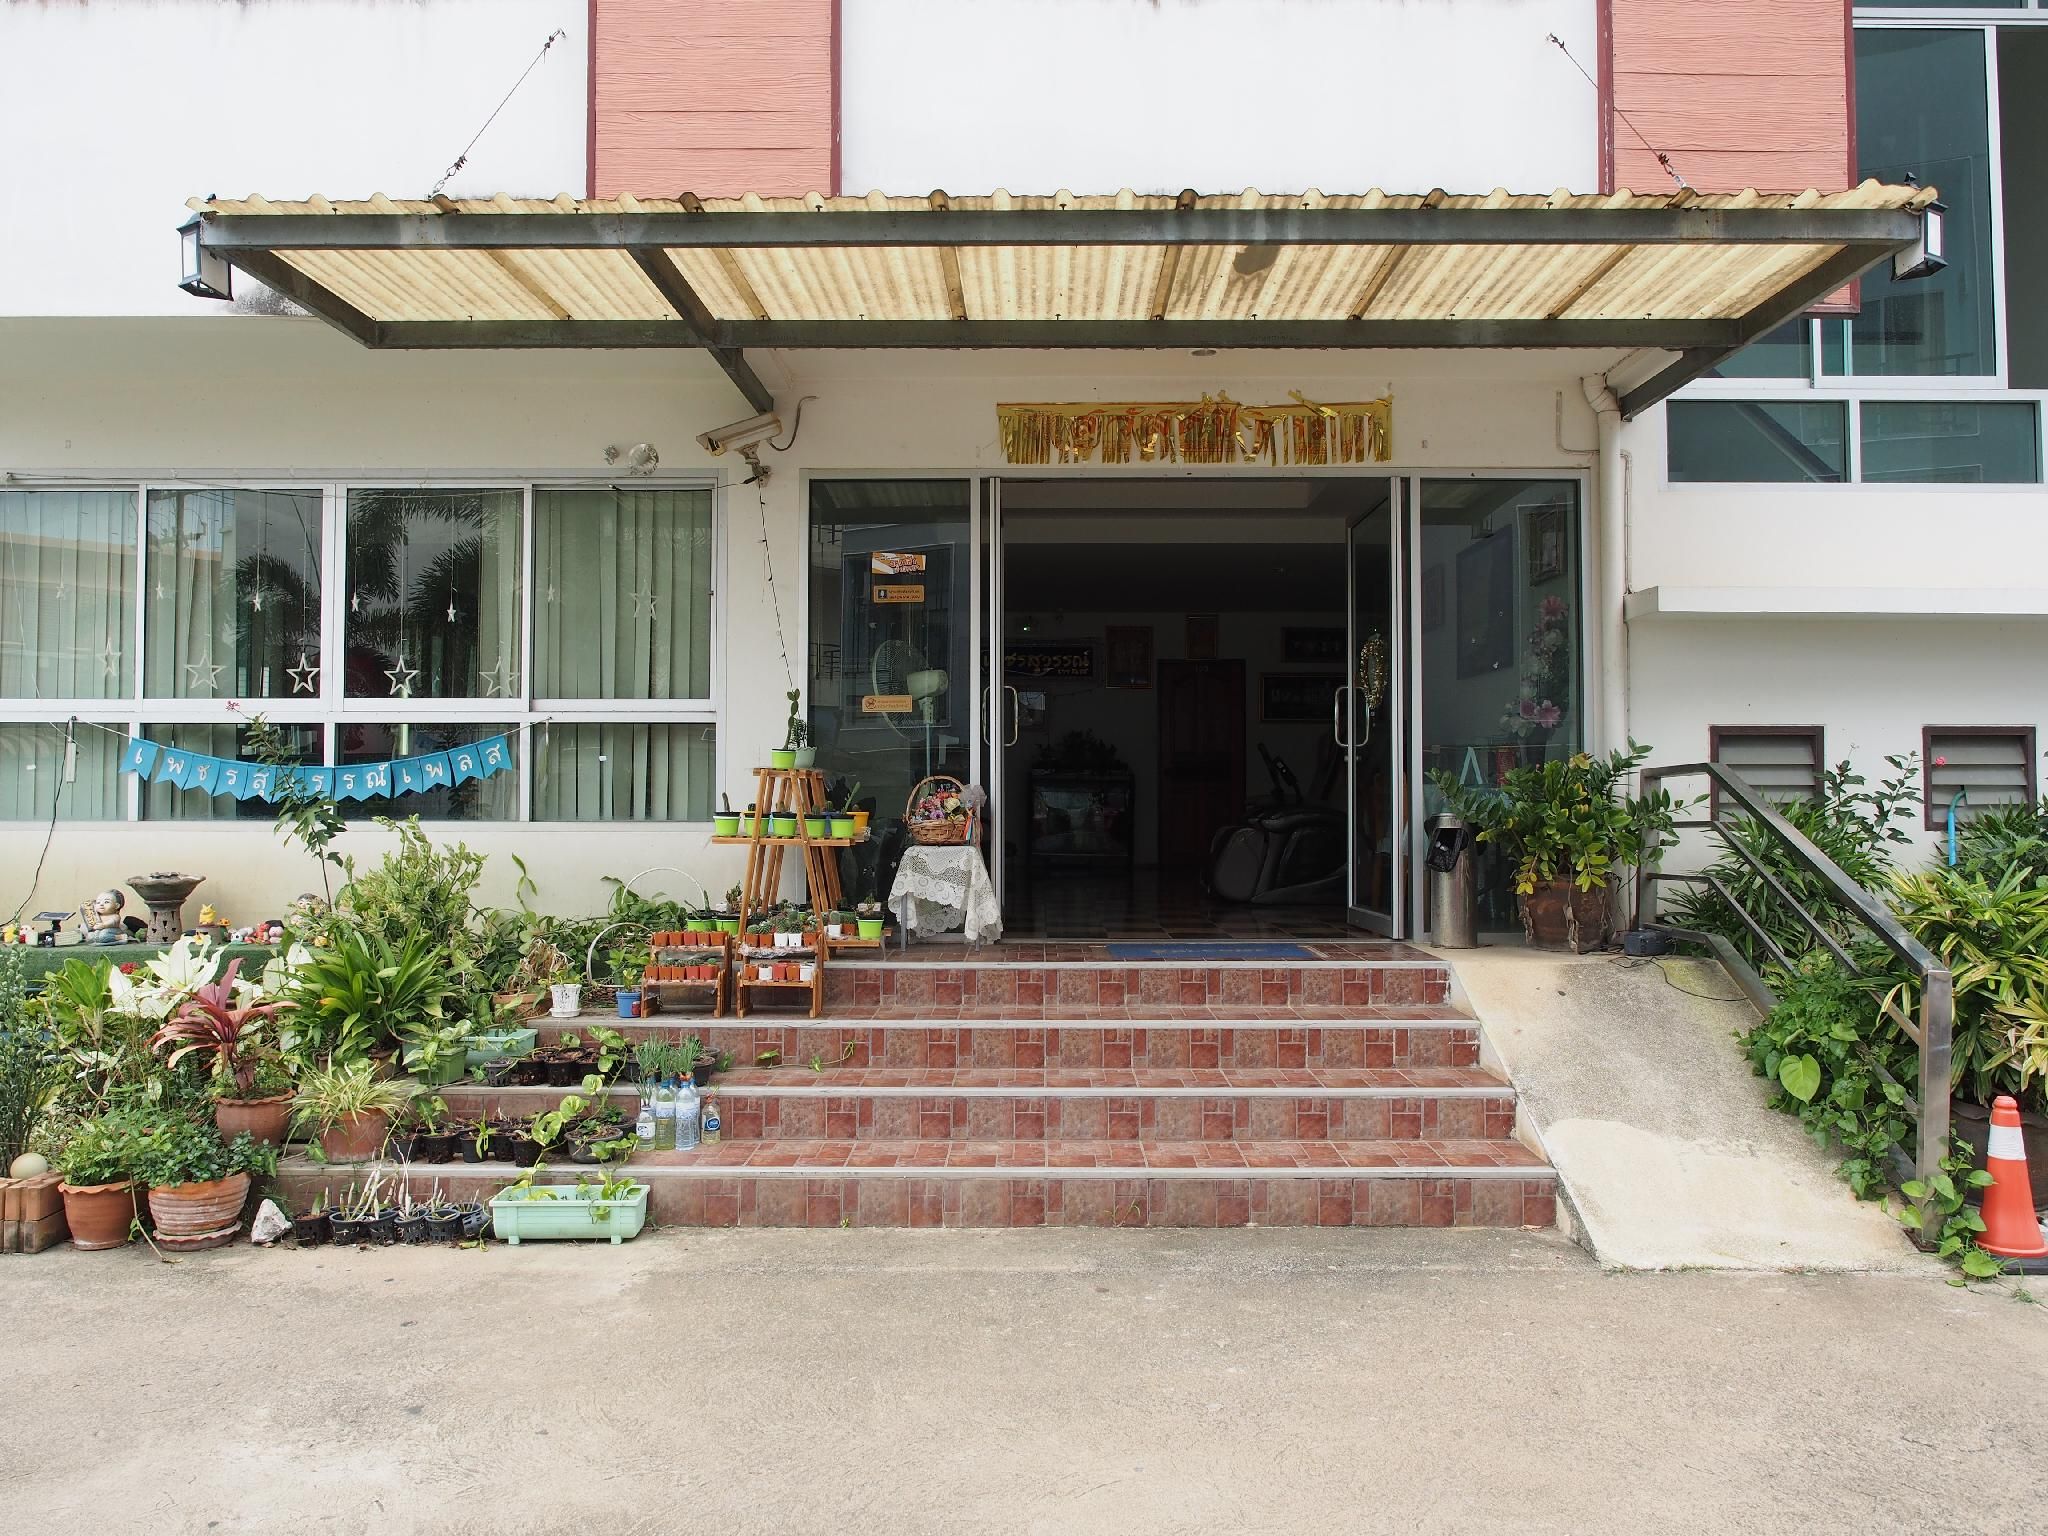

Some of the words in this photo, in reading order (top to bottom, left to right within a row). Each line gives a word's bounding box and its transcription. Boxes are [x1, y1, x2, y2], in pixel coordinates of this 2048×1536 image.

[135, 744, 502, 797] เพชรสุรรณ์เพลส
